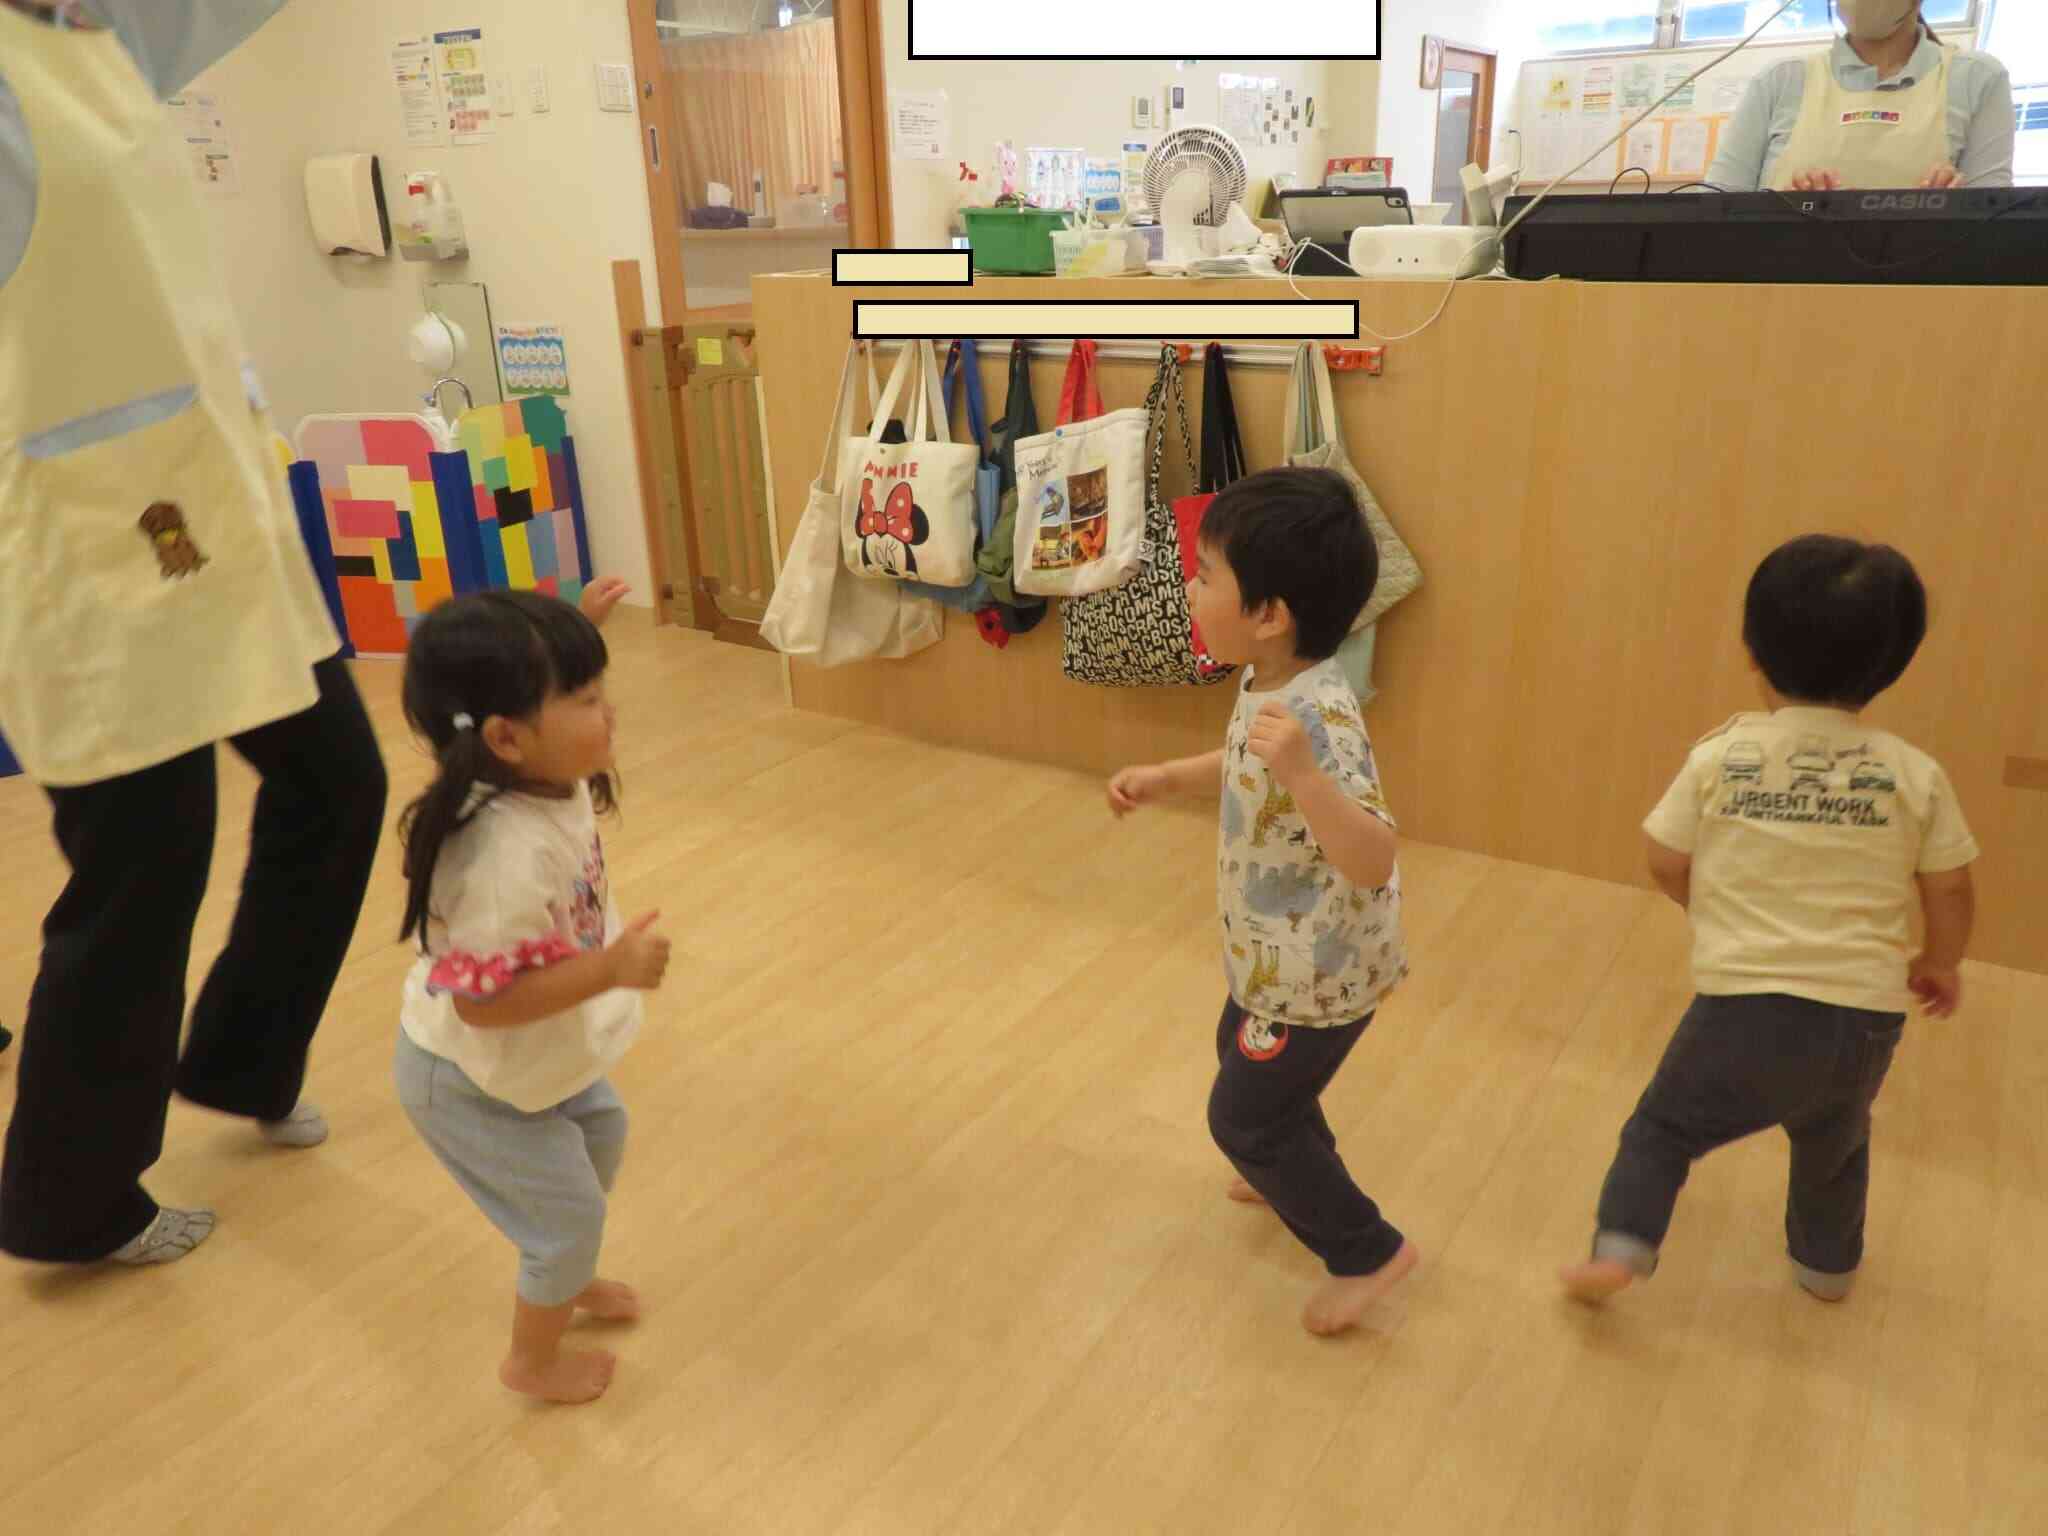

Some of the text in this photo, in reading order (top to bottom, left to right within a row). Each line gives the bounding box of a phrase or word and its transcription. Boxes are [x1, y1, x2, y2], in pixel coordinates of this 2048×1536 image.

[1860, 193, 1948, 210] CASIO
[863, 459, 919, 478] ANNIE
[1733, 791, 1875, 814] URGENT WORK
